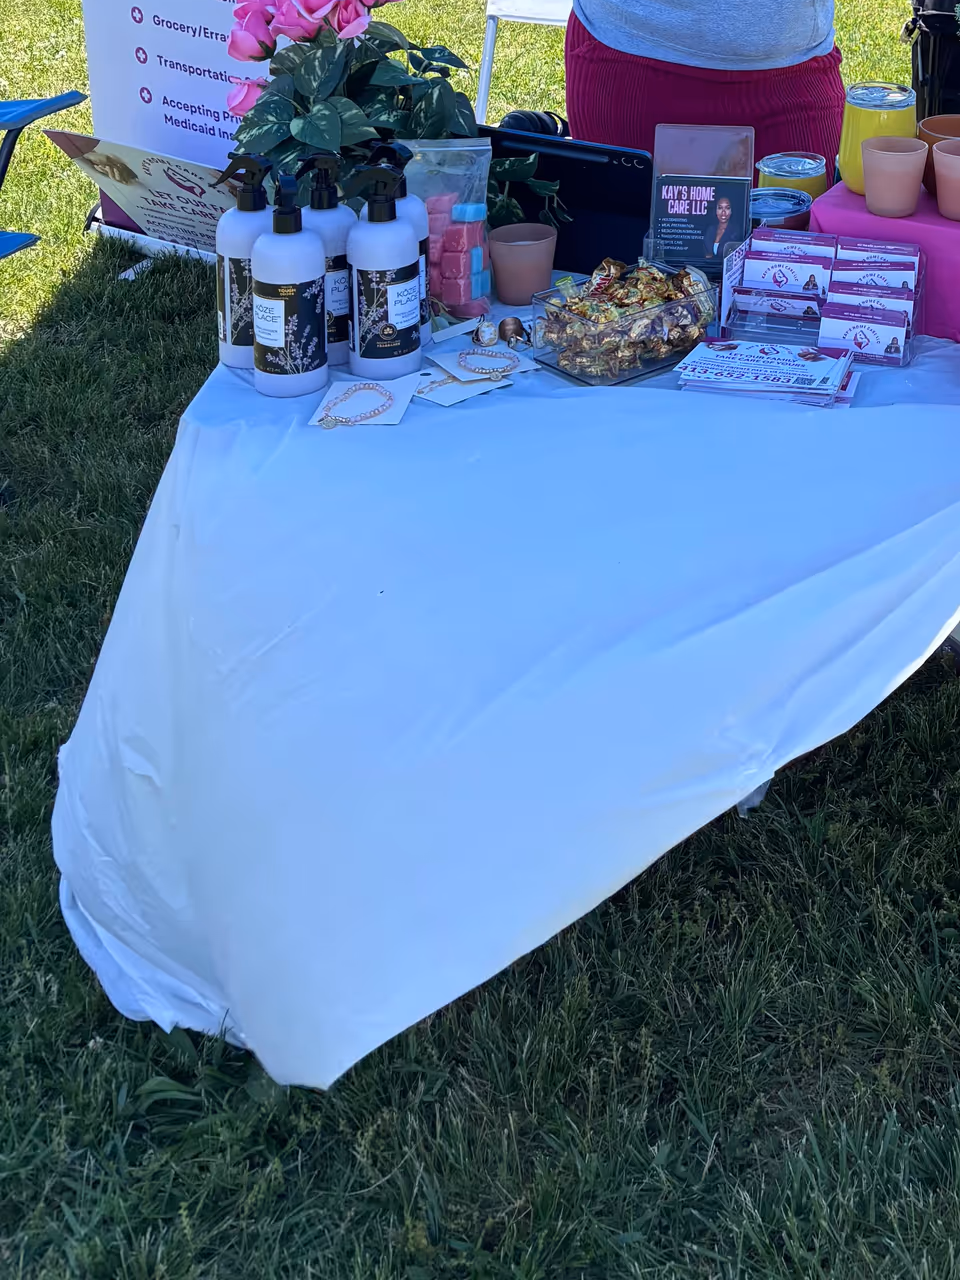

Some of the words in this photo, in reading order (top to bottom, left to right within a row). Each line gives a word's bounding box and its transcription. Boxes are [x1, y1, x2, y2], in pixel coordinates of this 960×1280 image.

[152, 14, 229, 43] Grocery/Erra
[162, 95, 220, 123] Accepting
[163, 113, 216, 137] Medicaid
[148, 188, 175, 201] LET
[176, 195, 211, 210] OUR
[209, 203, 227, 214] FA
[661, 185, 688, 200] KAY'S
[690, 186, 716, 201] HOME
[140, 195, 181, 213] TAKE
[180, 206, 219, 222] CARE
[668, 200, 690, 215] CARE
[691, 201, 708, 215] LLC
[678, 365, 792, 384] 413-652-1583
